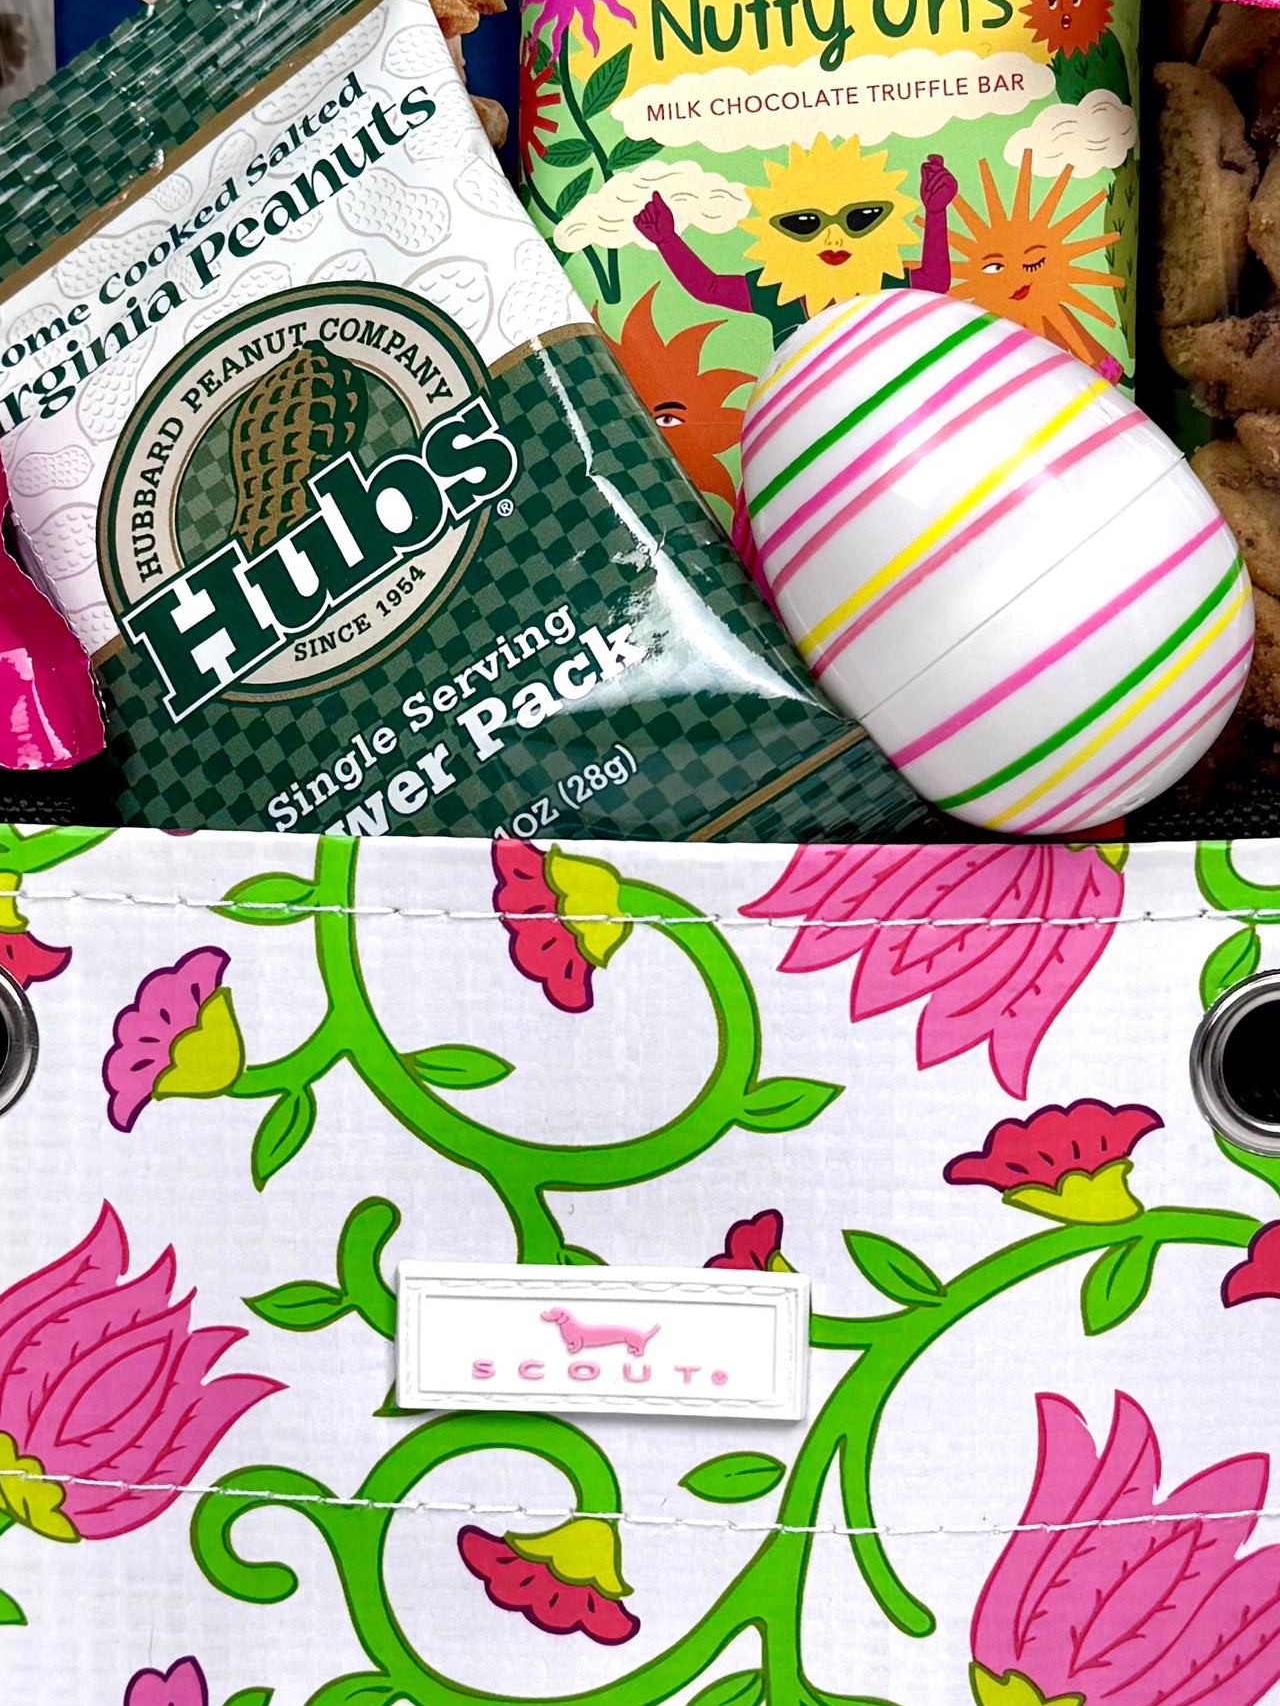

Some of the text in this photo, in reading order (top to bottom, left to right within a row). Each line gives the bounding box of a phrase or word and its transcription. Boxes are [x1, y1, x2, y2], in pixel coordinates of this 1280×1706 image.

[98, 177, 241, 306] Cooked
[245, 70, 367, 187] Salted
[186, 85, 437, 290] Peanuts
[646, 73, 1025, 123] MILK CHOCOLATE TRUFFLE BAR
[131, 316, 453, 583] HUBBARD PEANUT COMPANY
[121, 396, 518, 724] Hubs
[293, 564, 427, 662] SINCE 1954
[267, 603, 578, 833] Single Serving
[324, 622, 646, 838] wer Pack
[557, 743, 638, 810] (28g)
[471, 1358, 702, 1385] SCOUT
